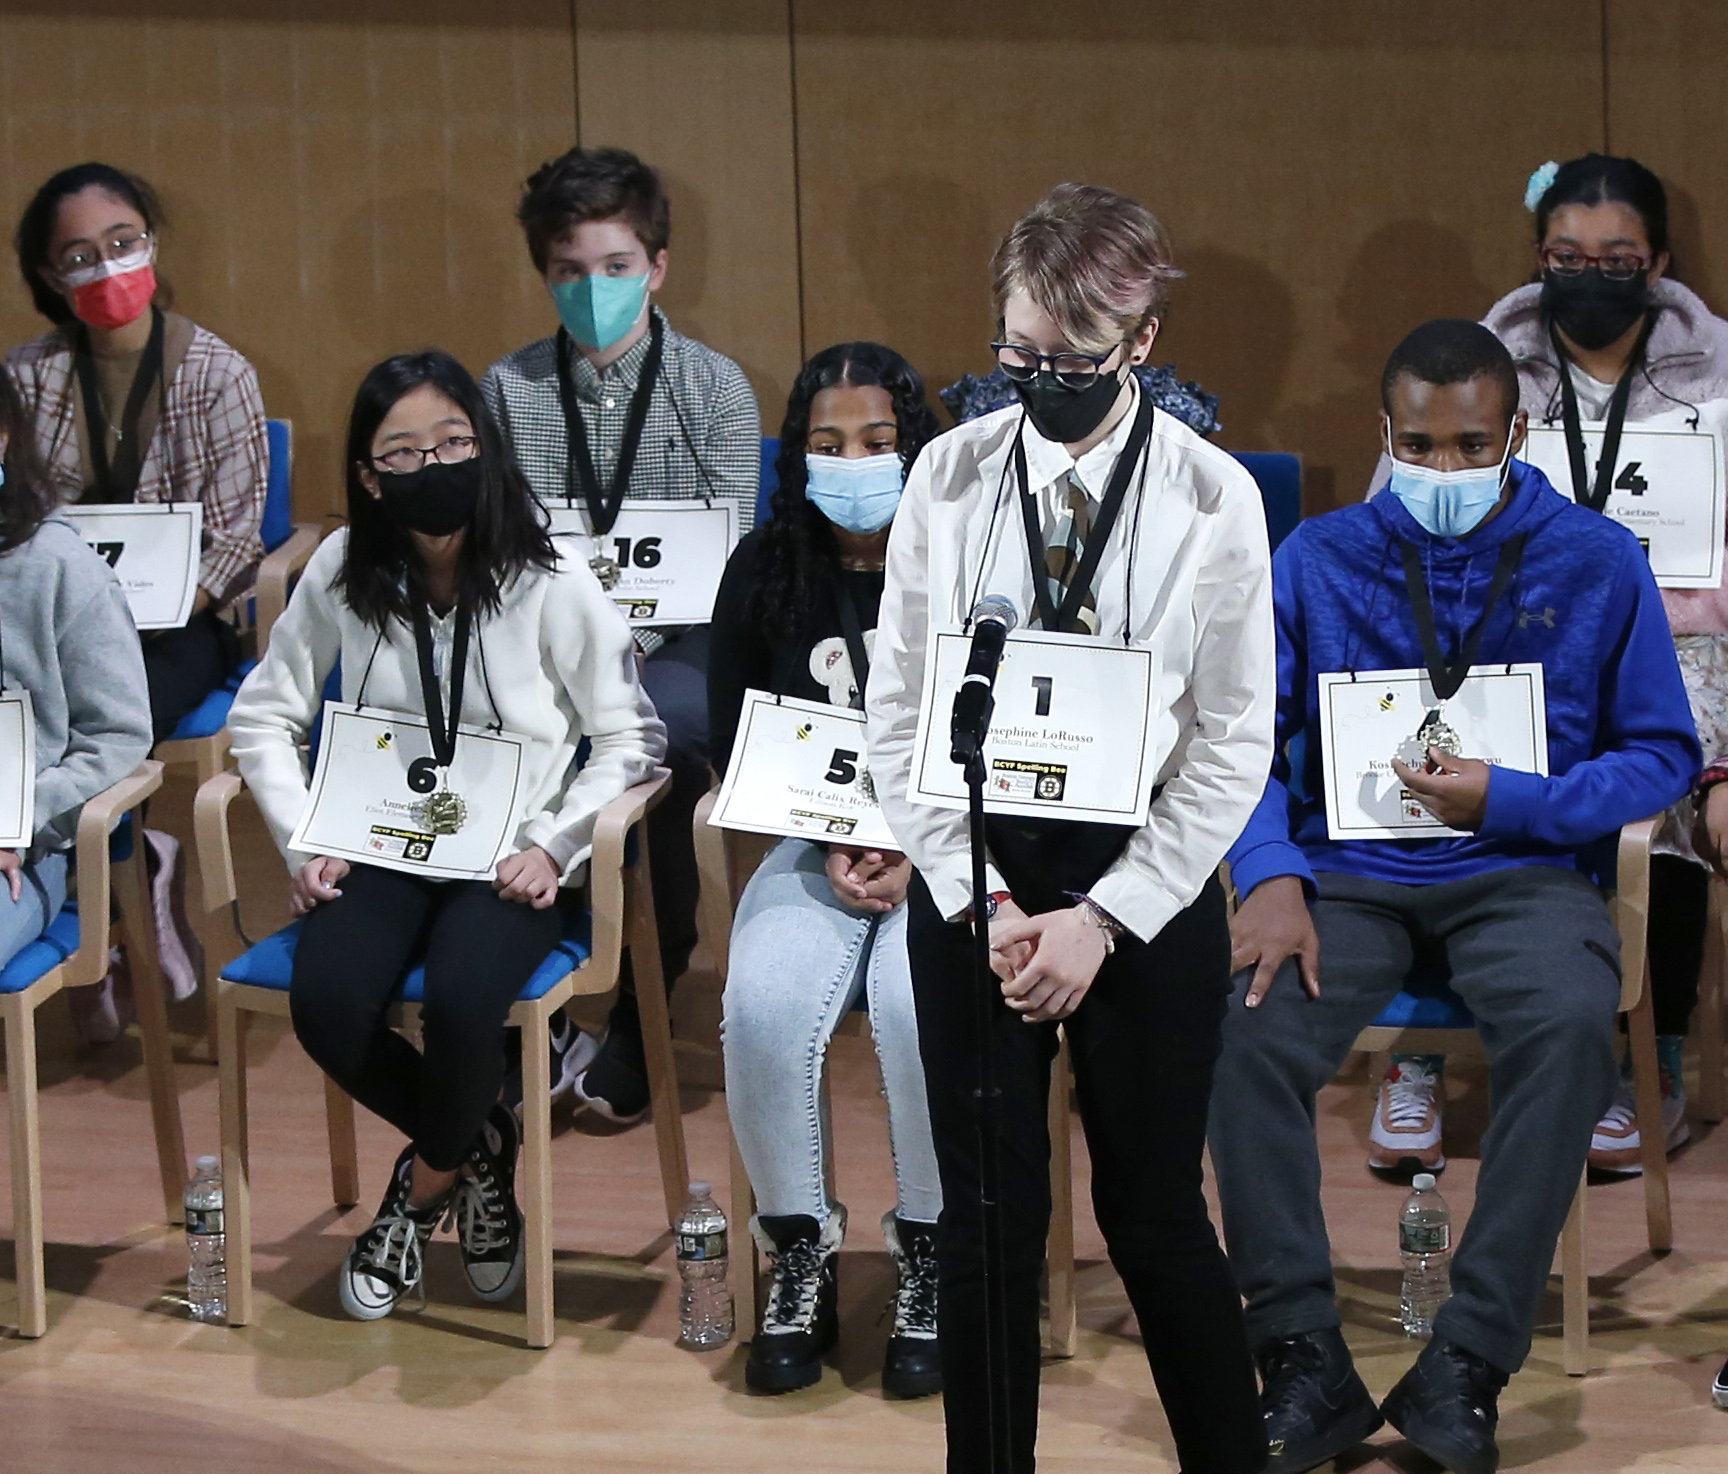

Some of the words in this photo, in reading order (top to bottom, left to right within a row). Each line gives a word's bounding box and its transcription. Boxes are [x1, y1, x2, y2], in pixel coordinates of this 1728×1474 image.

[86, 541, 125, 569] 7
[613, 536, 663, 568] 16
[1031, 675, 1054, 717] 1
[984, 725, 1039, 740] osephine
[1042, 728, 1094, 744] LoRusso
[407, 756, 439, 794] 6
[823, 747, 859, 785] 5
